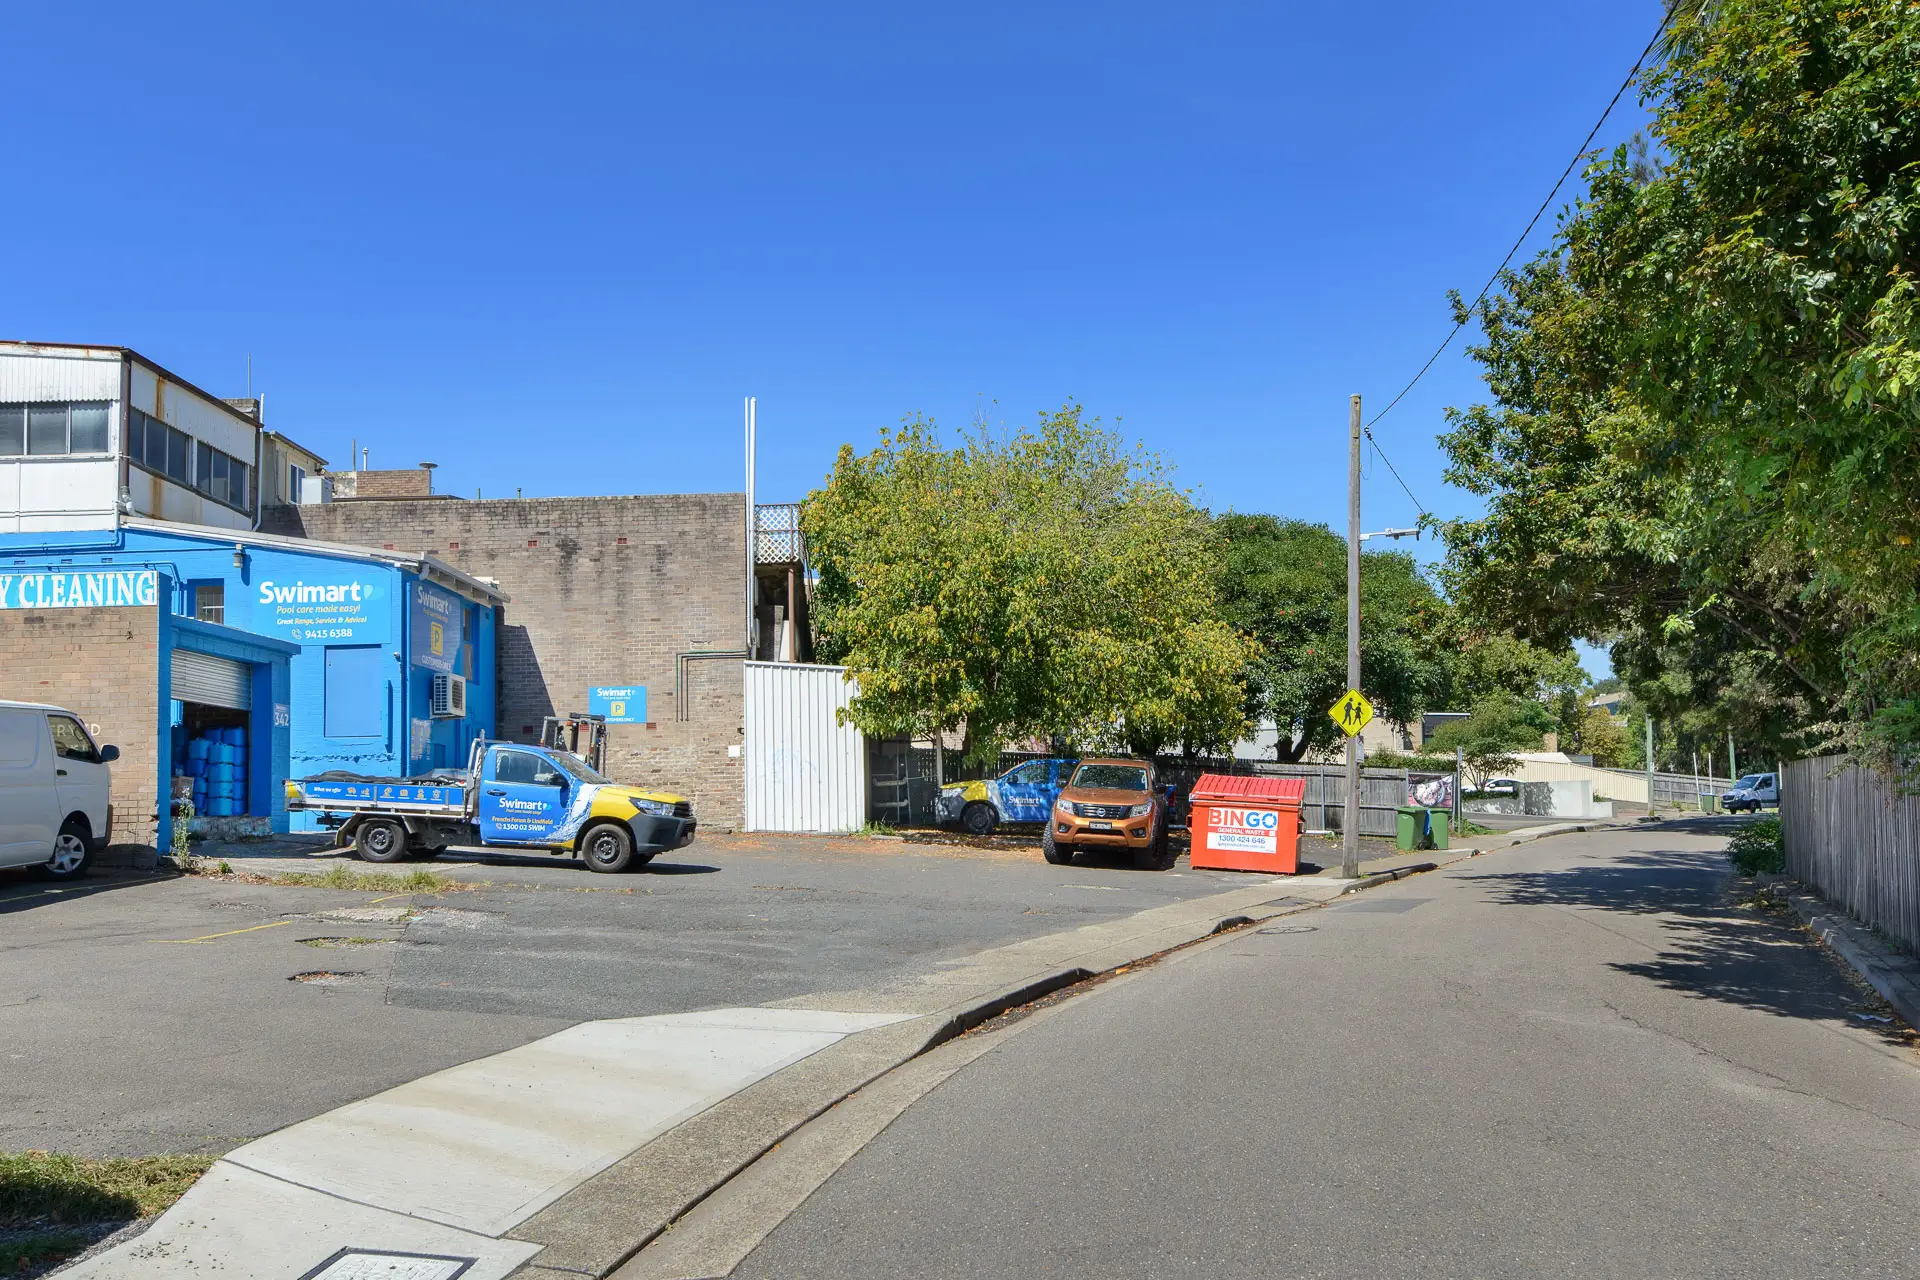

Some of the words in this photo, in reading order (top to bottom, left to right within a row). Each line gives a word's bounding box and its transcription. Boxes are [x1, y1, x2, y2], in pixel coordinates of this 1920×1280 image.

[18, 572, 155, 608] CLEANING
[259, 581, 361, 604] Swimart
[417, 586, 449, 615] Swimart
[276, 605, 294, 614] Pool
[315, 604, 338, 613] made
[339, 604, 361, 614] easy!
[305, 629, 328, 638] 9415
[329, 628, 353, 637] 6388
[597, 688, 631, 697] Swimart
[274, 711, 289, 726] 342
[499, 797, 542, 810] Swimart
[1009, 795, 1039, 804] Swimart
[1209, 810, 1277, 828] BINGO
